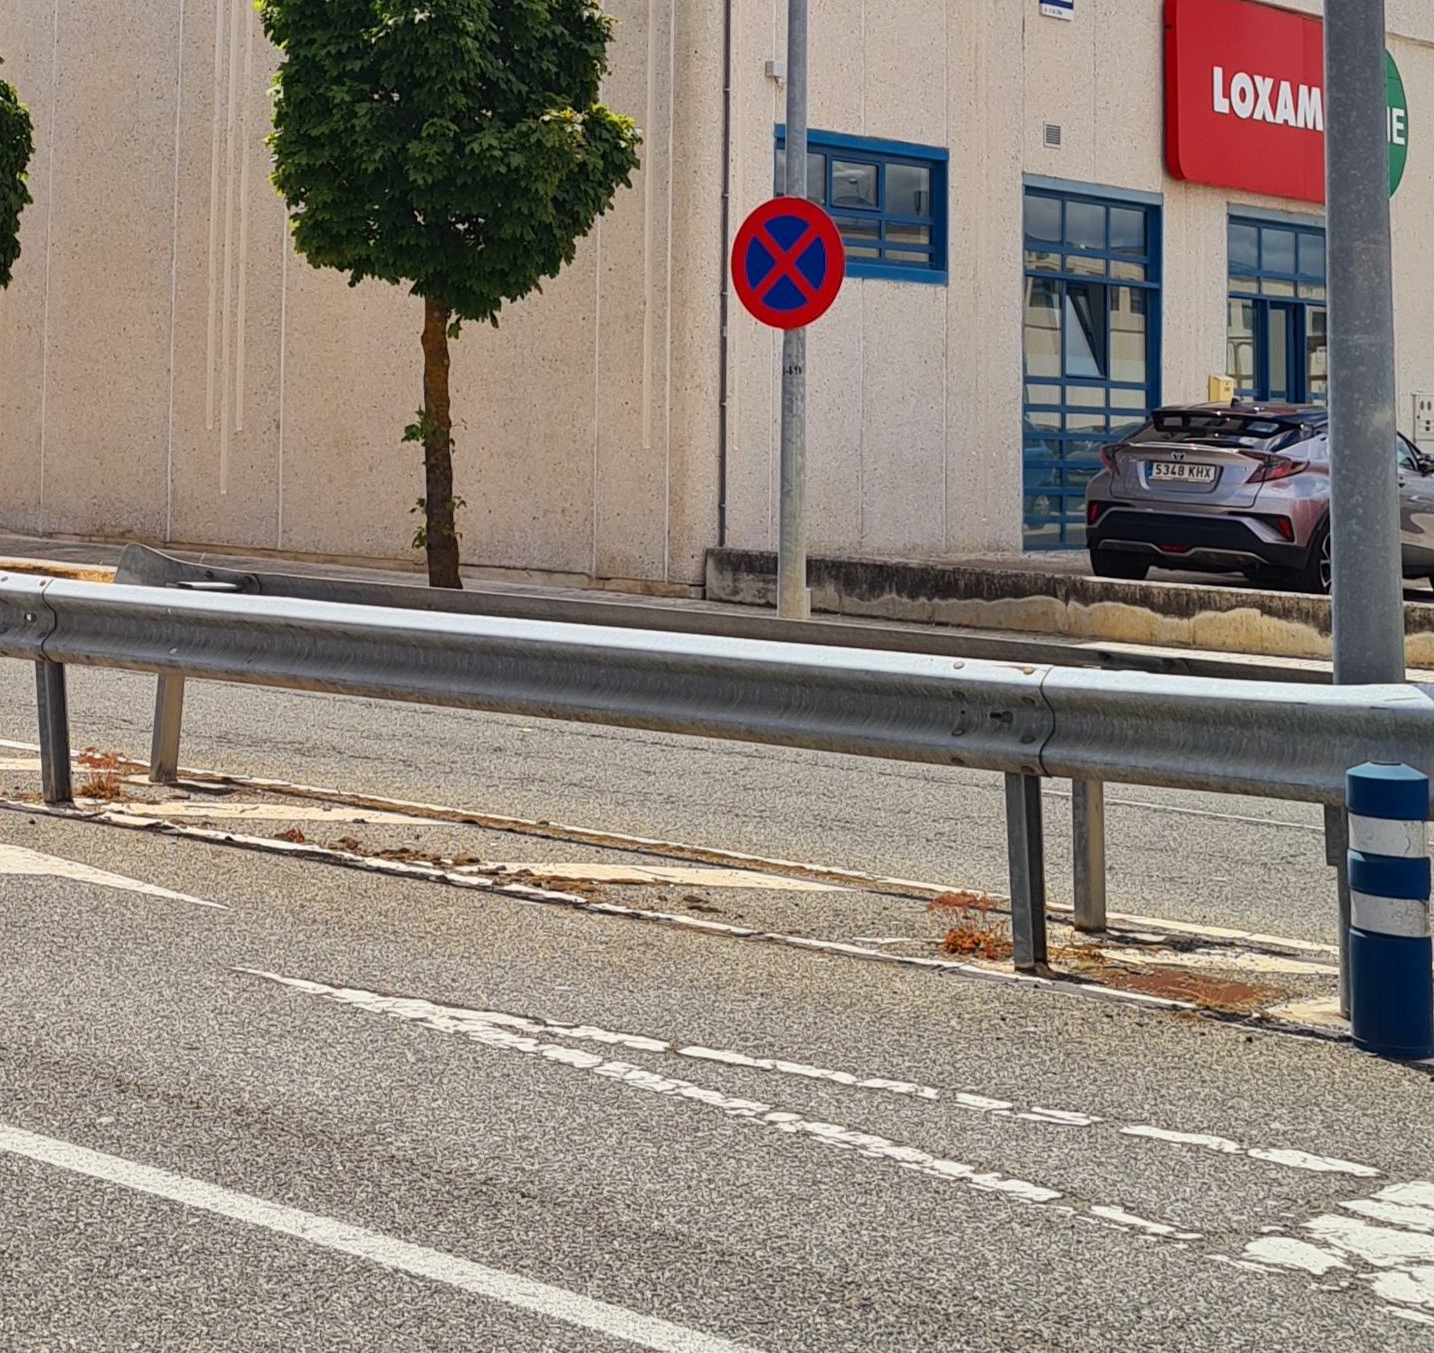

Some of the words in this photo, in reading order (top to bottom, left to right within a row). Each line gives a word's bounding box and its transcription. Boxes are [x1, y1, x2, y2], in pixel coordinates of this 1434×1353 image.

[1212, 65, 1324, 132] LOXAM
[1155, 463, 1184, 477] 5348
[1187, 466, 1212, 479] KHX
